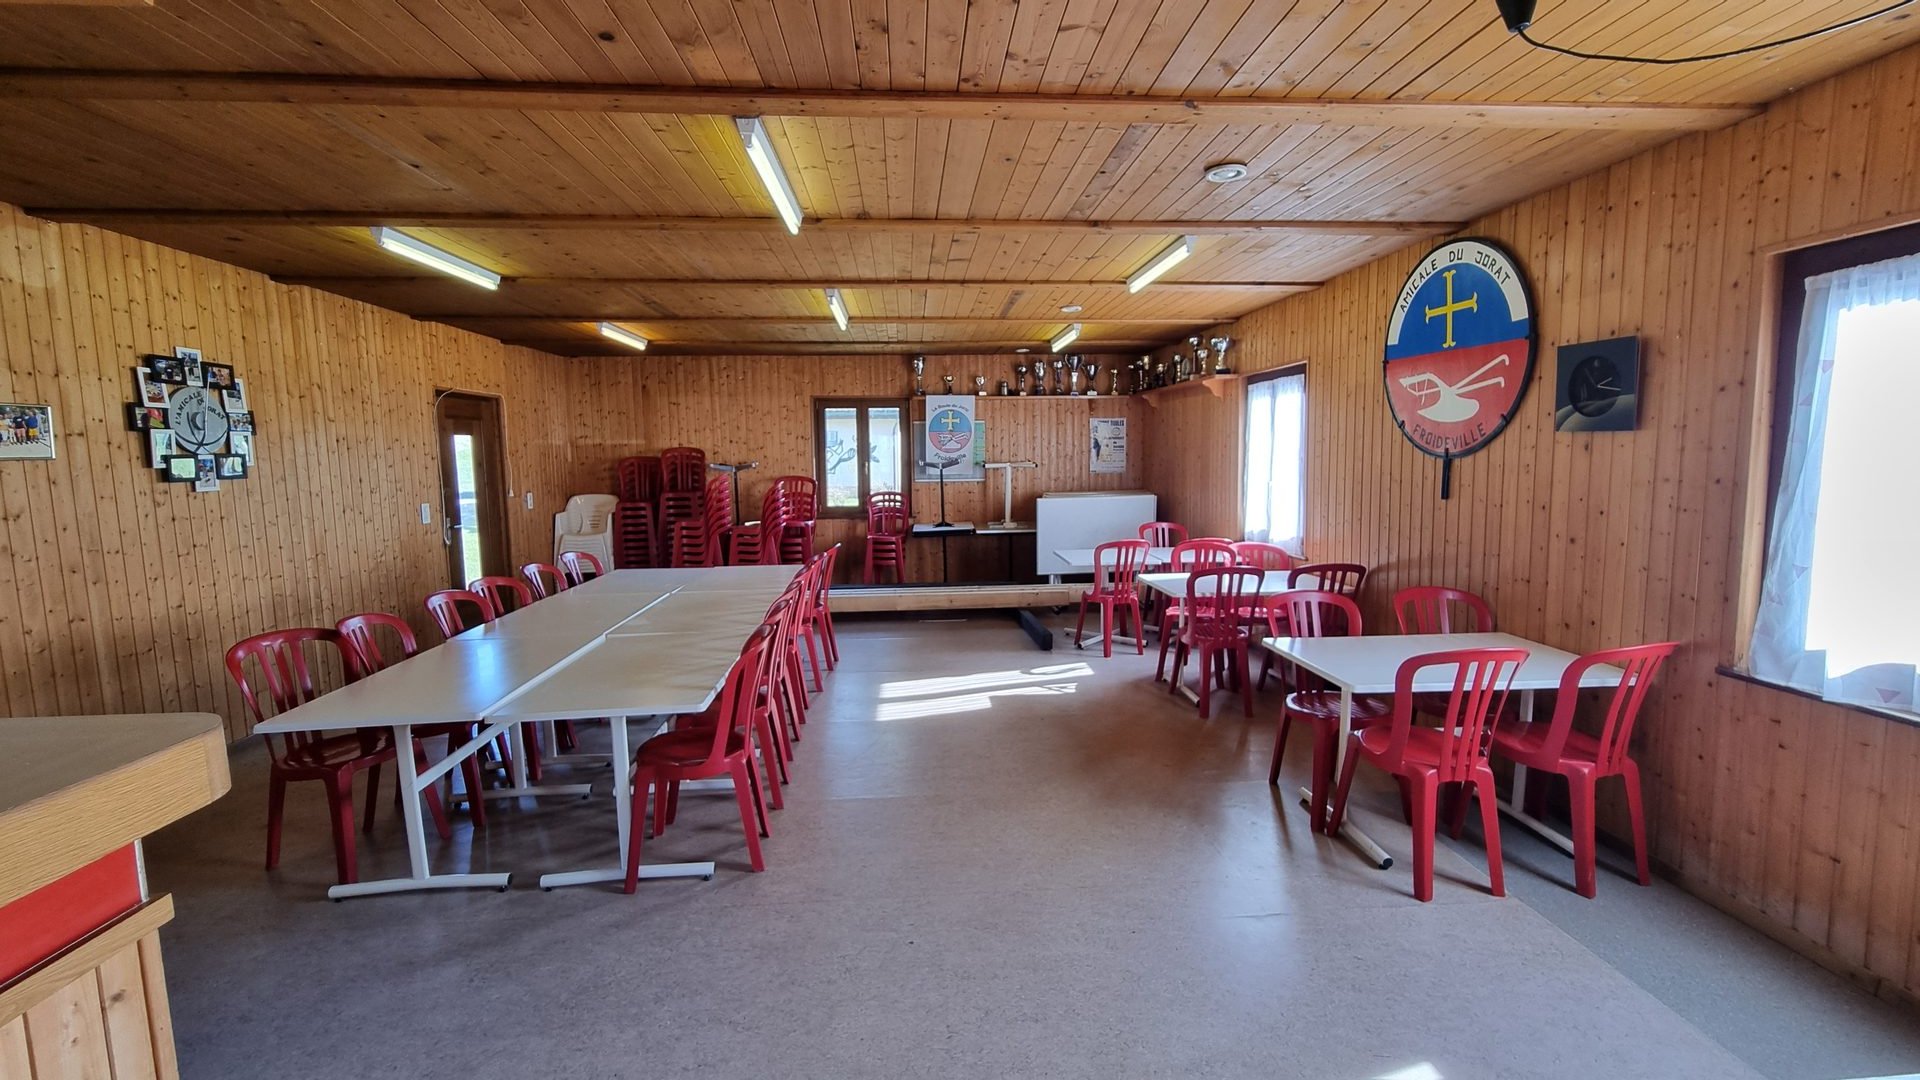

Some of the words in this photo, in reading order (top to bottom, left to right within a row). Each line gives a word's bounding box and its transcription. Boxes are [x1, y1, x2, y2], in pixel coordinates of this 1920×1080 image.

[1400, 258, 1438, 313] AMICALE
[1448, 248, 1464, 263] DU
[1474, 250, 1511, 285] JORAT
[1413, 422, 1486, 450] FROIDEVILLE
